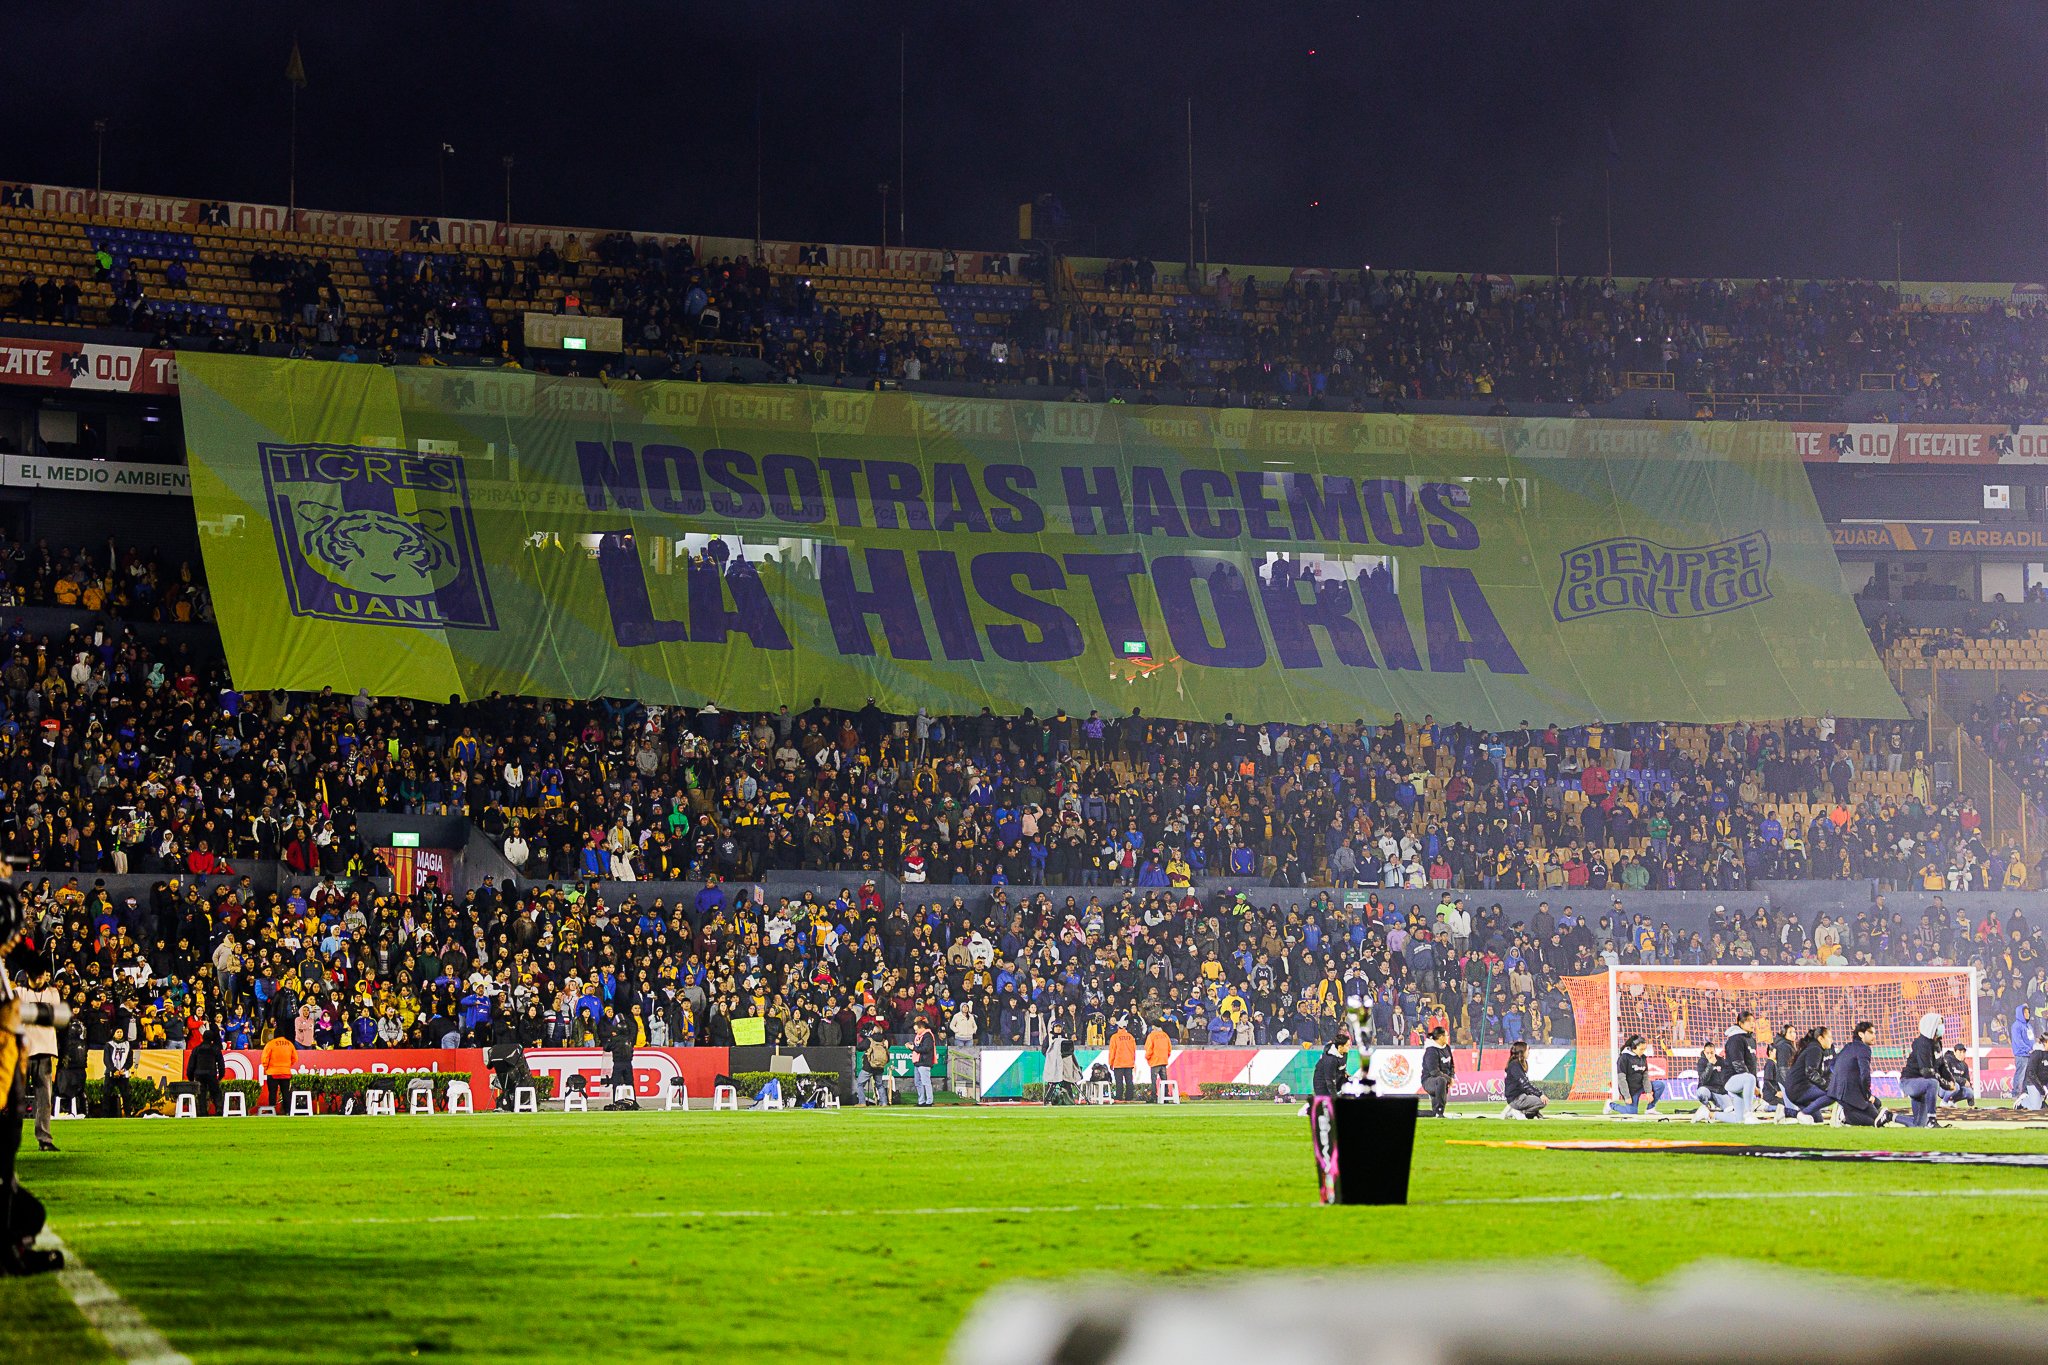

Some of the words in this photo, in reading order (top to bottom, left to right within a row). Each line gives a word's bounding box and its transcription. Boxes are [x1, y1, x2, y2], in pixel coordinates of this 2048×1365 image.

[96, 354, 132, 381] 0.0
[543, 385, 626, 413] TECATE
[903, 400, 1002, 434] TECATE
[1859, 433, 1891, 457] 0.0
[1904, 433, 1982, 457] TECATE
[21, 464, 42, 479] EL
[47, 465, 110, 483] MEDIO
[271, 452, 454, 490] TIGRES
[575, 439, 1044, 535] NOSOTRAS
[1060, 465, 1480, 550] HACEMOS
[1824, 529, 1890, 545] AZUARA
[1922, 528, 1934, 545] 7
[1569, 538, 1761, 587] SIEMPRE
[592, 527, 794, 650] LA
[812, 543, 1530, 674] HISTORIA
[1567, 568, 1763, 614] CONTIGO
[333, 592, 448, 620] UANL
[416, 850, 443, 873] MAGIA
[1450, 1080, 1487, 1097] BBVA
